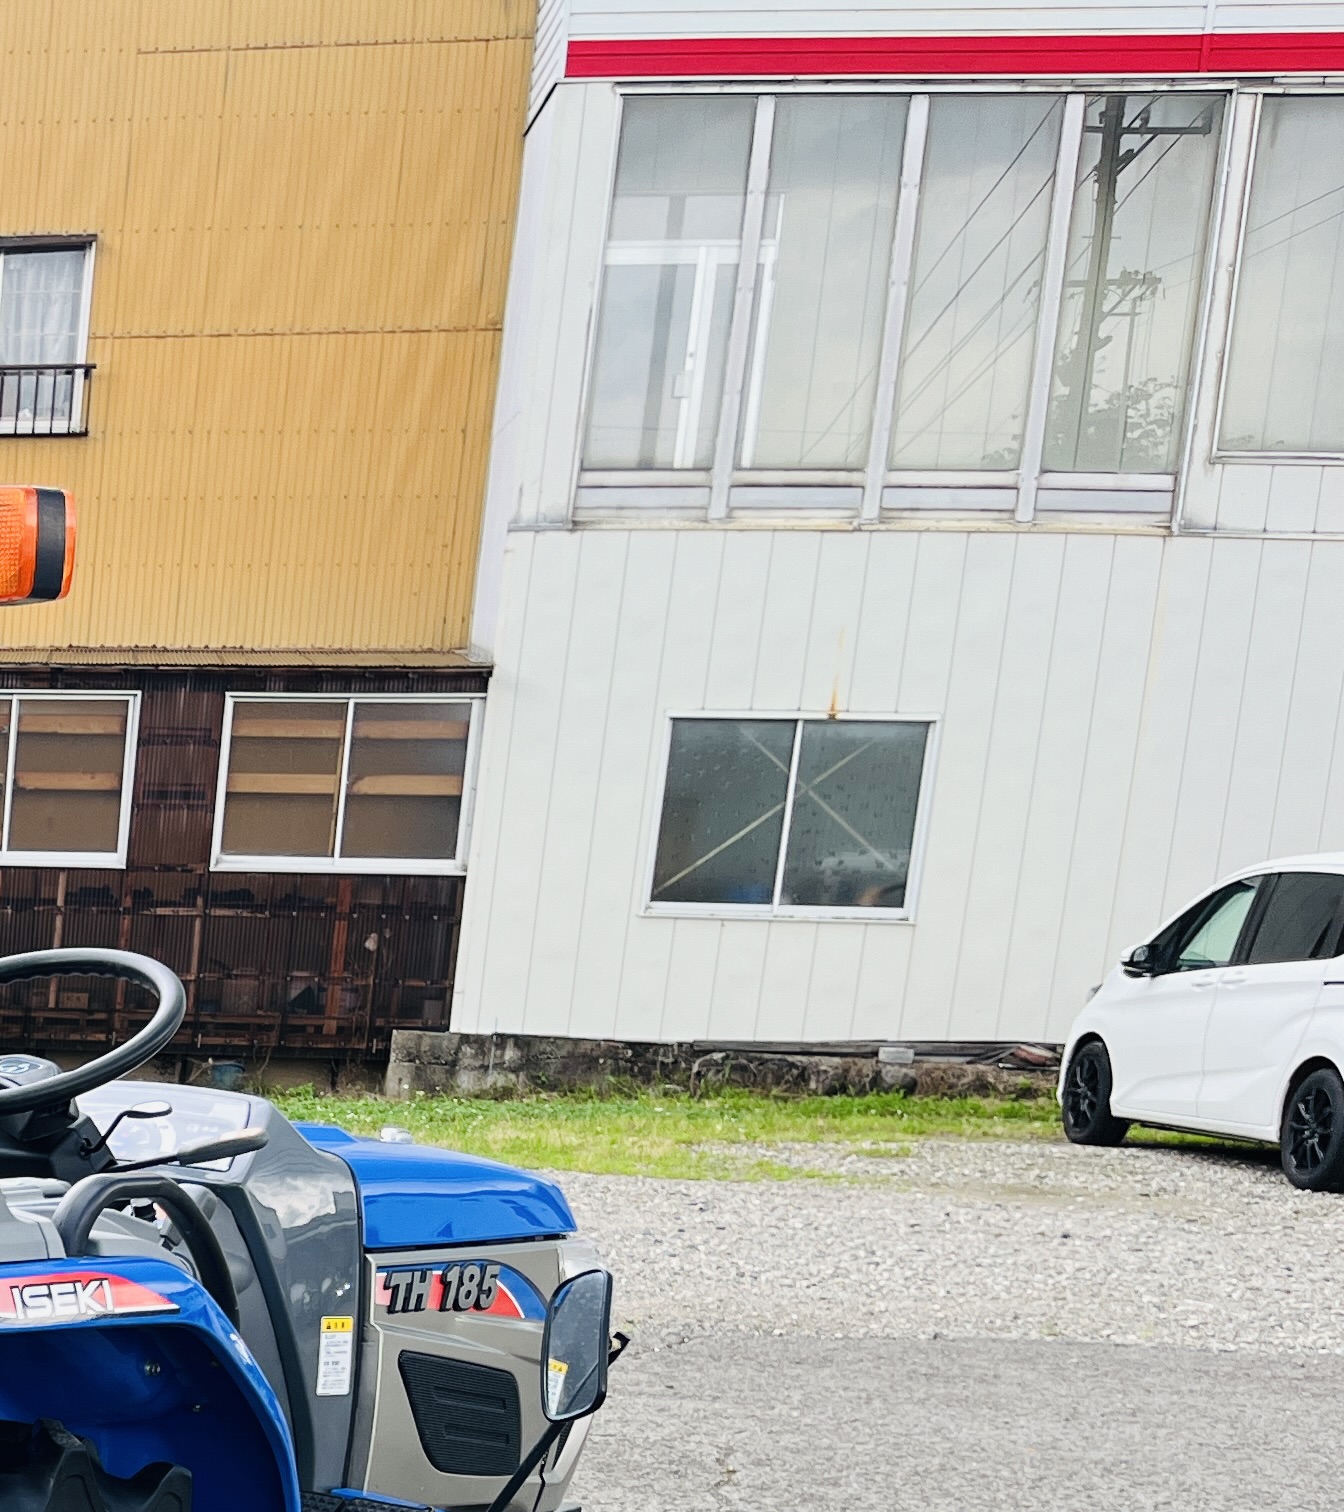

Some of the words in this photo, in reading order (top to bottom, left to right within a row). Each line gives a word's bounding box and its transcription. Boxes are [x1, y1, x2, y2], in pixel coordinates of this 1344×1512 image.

[10, 1279, 114, 1319] ISEKI
[388, 1271, 432, 1312] TH
[444, 1265, 500, 1310] 185
